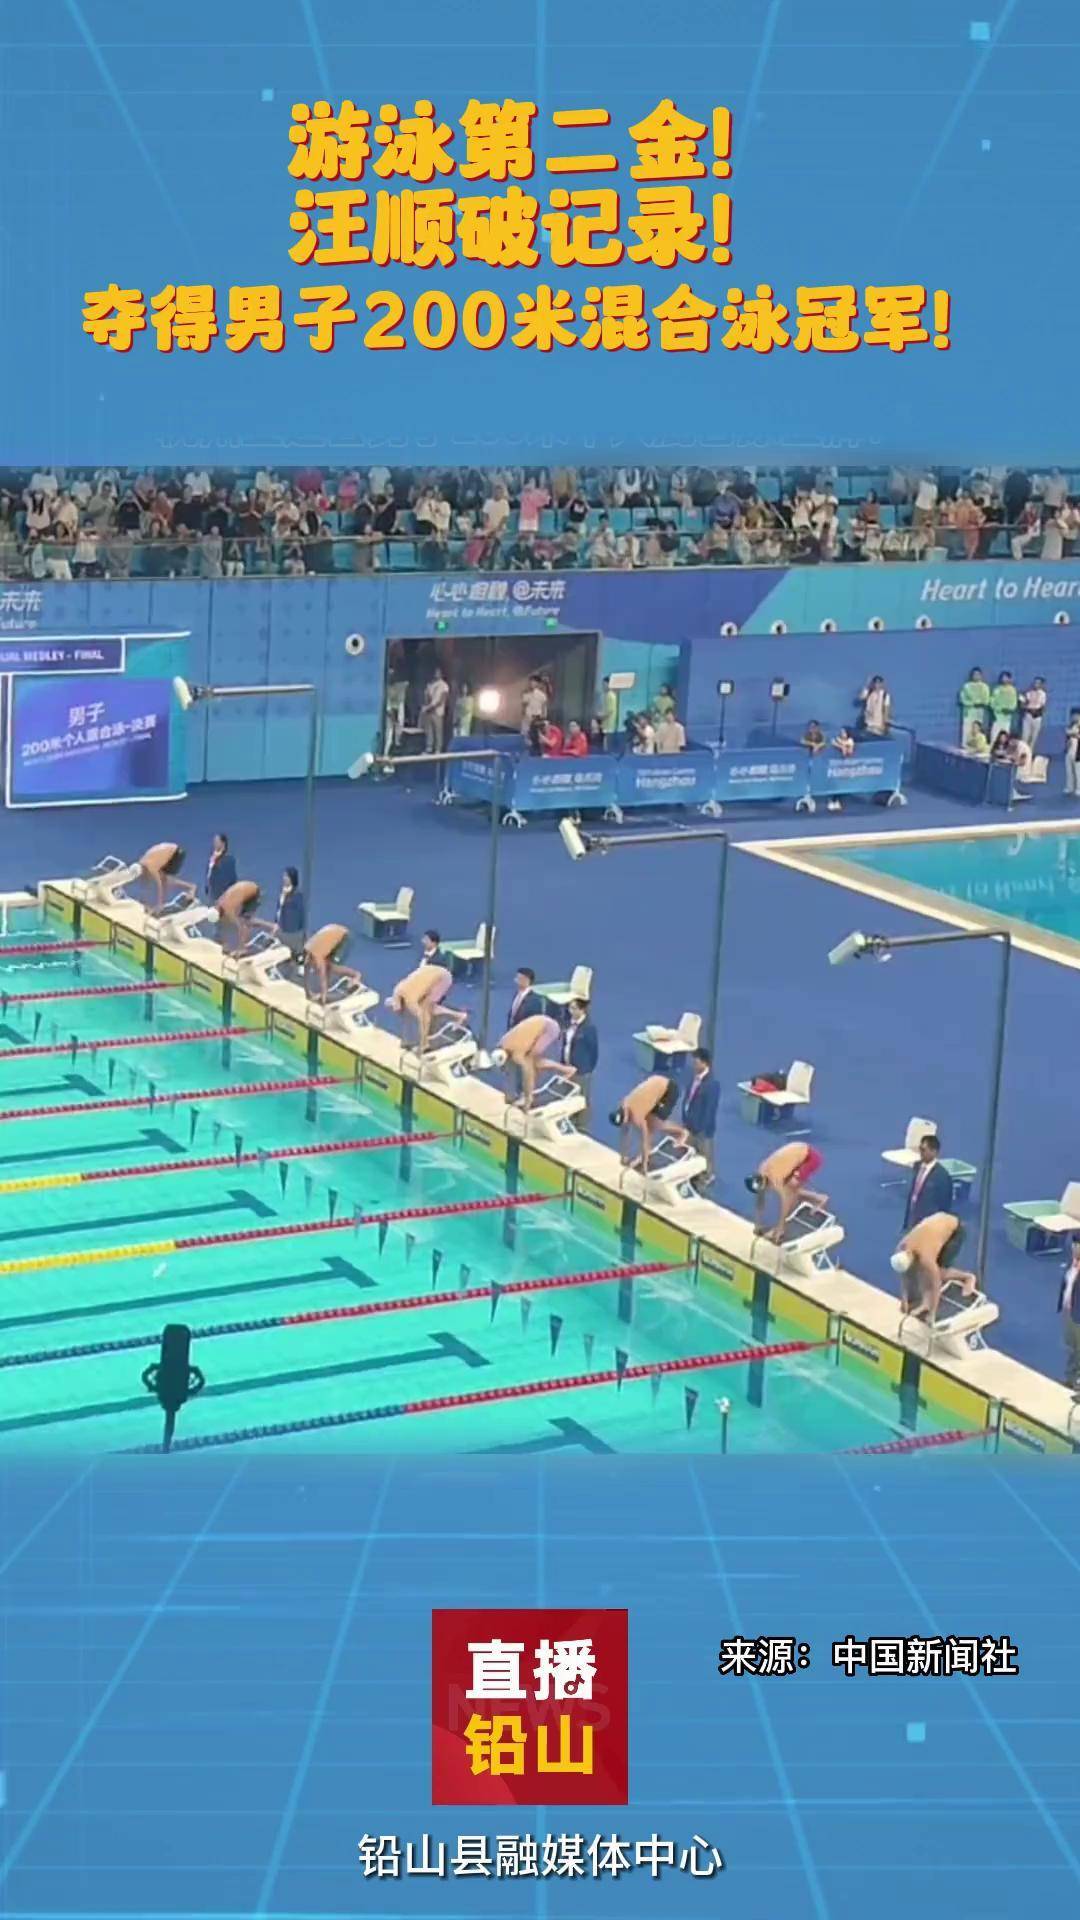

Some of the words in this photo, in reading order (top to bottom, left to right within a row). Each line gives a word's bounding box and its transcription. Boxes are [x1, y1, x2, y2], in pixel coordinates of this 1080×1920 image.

[920, 578, 988, 600] Heart
[995, 577, 1018, 599] to
[0, 589, 42, 613] 未来
[68, 701, 105, 728] 男子
